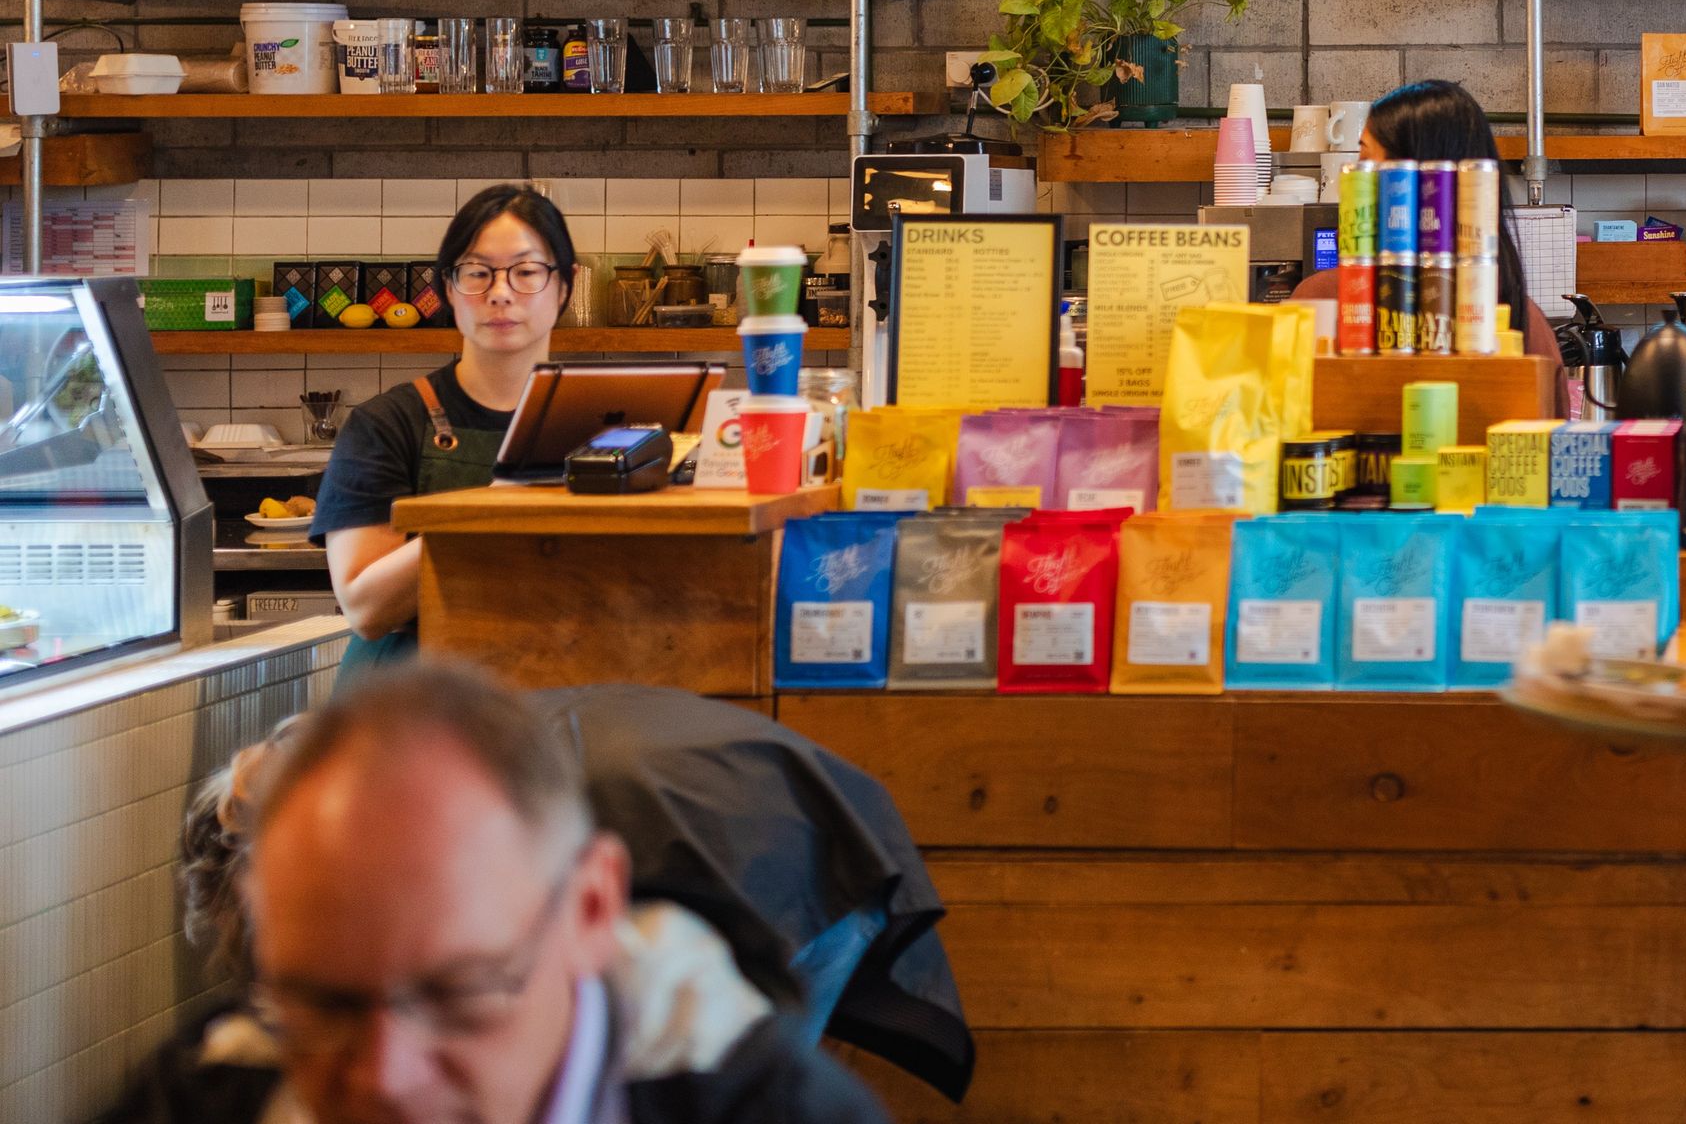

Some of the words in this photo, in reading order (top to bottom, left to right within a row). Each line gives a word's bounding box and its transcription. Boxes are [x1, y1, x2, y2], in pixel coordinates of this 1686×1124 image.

[253, 43, 280, 52] CRUNCHY
[346, 44, 379, 56] PEANUT
[254, 52, 276, 61] PEANUT
[254, 61, 277, 71] BUTTER
[907, 228, 984, 244] DRINKS
[1095, 230, 1169, 247] COFFEE
[1175, 230, 1242, 247] BEANS
[1643, 230, 1676, 240] Sunshine
[1488, 433, 1545, 454] SPECIAL
[1551, 433, 1608, 455] SPECIAL
[1488, 455, 1538, 476] COFFEE
[1551, 455, 1601, 476] COFFEE
[1488, 476, 1527, 497] PODS
[1551, 476, 1590, 498] PODS
